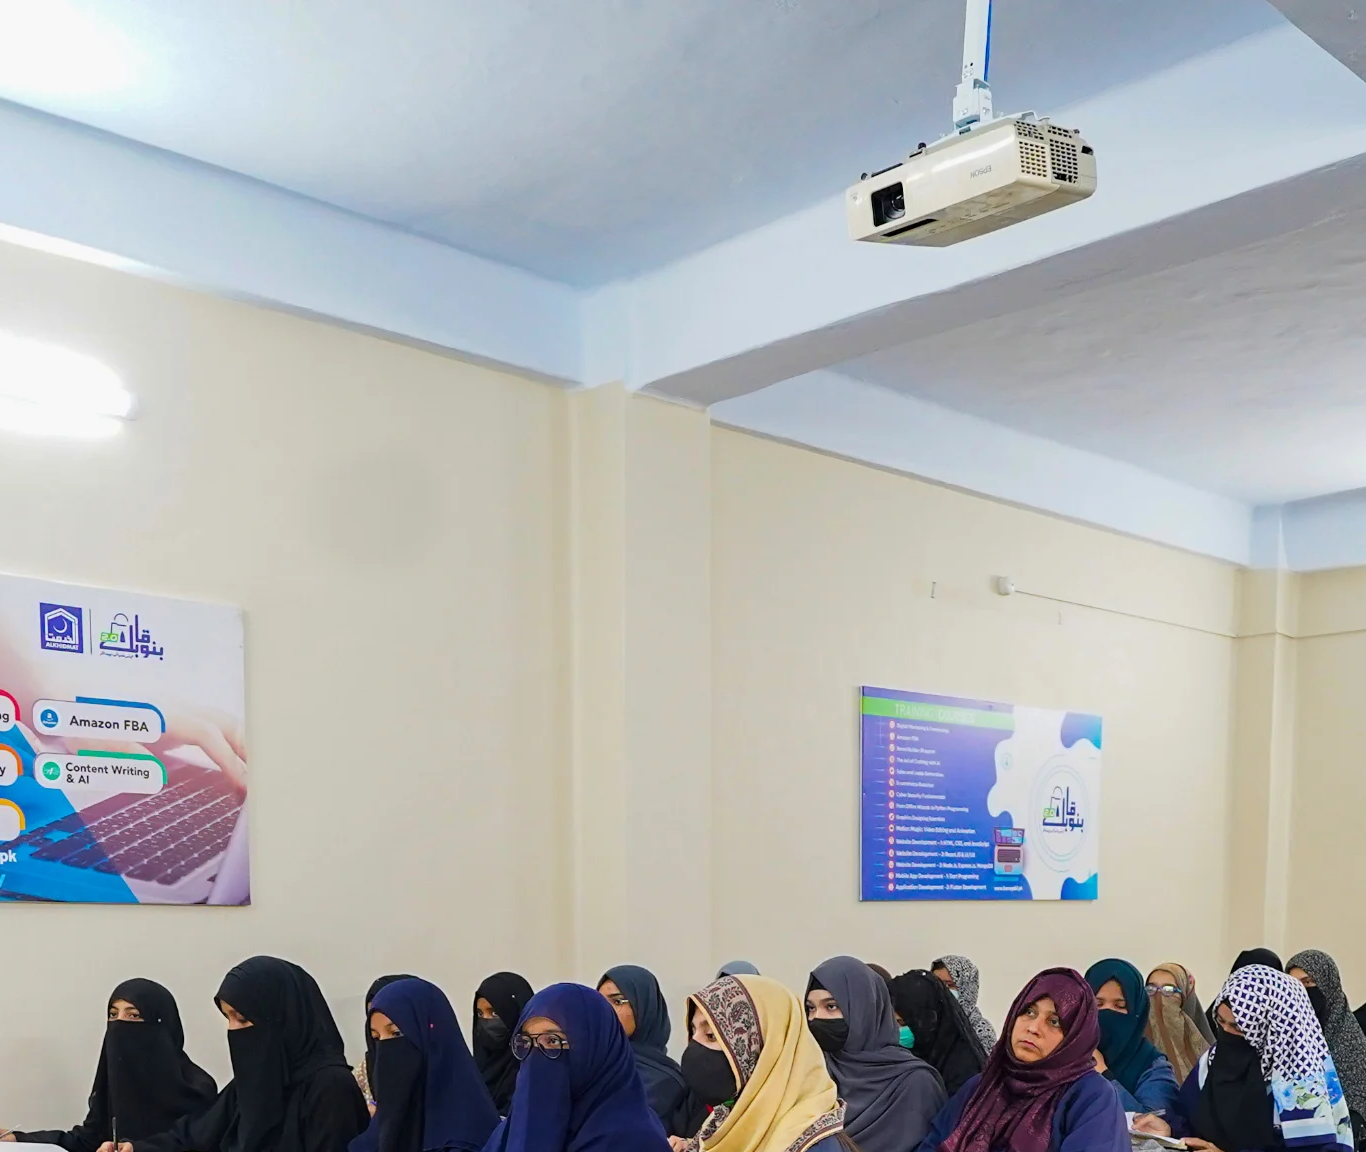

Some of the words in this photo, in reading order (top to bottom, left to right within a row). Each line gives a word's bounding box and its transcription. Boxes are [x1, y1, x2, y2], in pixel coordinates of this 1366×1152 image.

[970, 165, 992, 178] EPSON
[101, 633, 118, 642] 2.0
[45, 641, 79, 650] ALKHIDMAT
[69, 716, 120, 730] Amazon
[124, 720, 149, 732] FBA
[65, 762, 109, 775] Content
[111, 765, 150, 779] Writing
[66, 774, 75, 784] &
[78, 775, 89, 785] AI
